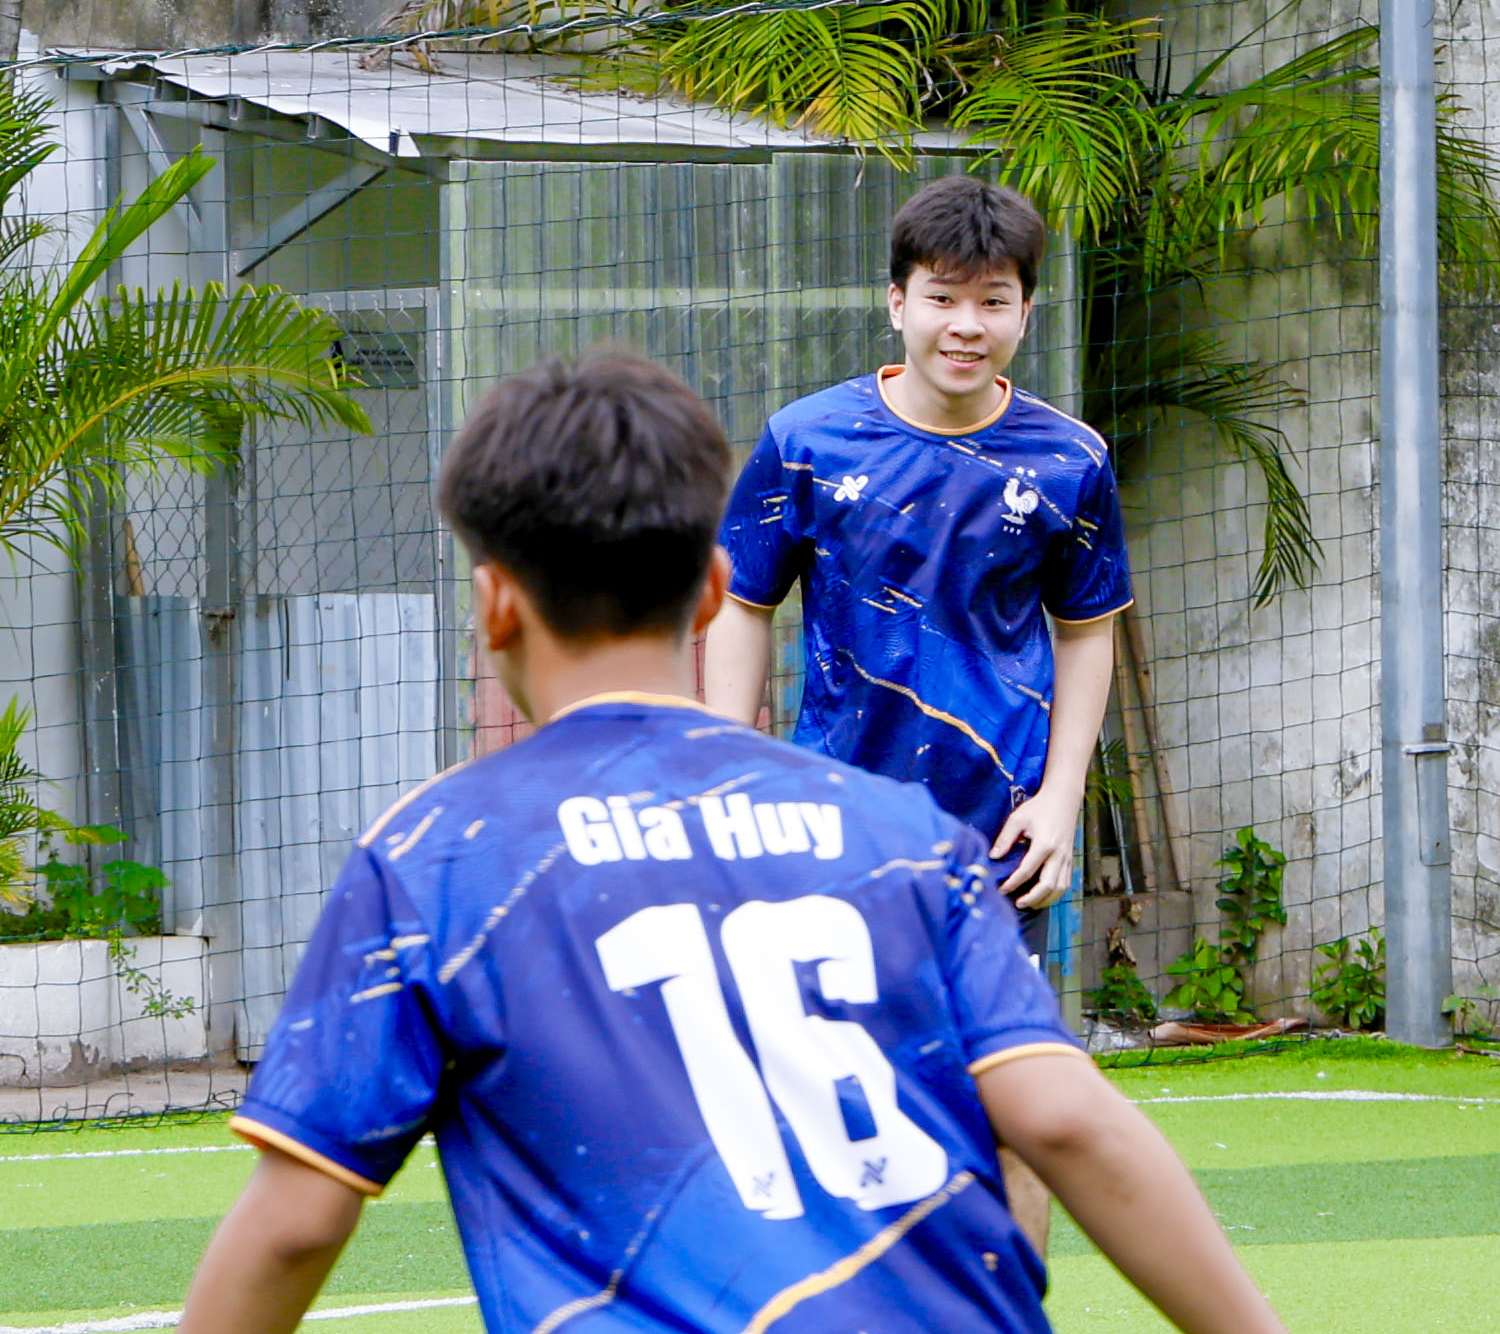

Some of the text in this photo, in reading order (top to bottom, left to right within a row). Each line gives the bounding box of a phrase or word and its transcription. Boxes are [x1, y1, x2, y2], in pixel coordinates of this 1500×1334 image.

[557, 791, 845, 866] Gia Huy
[595, 893, 949, 1220] 16
